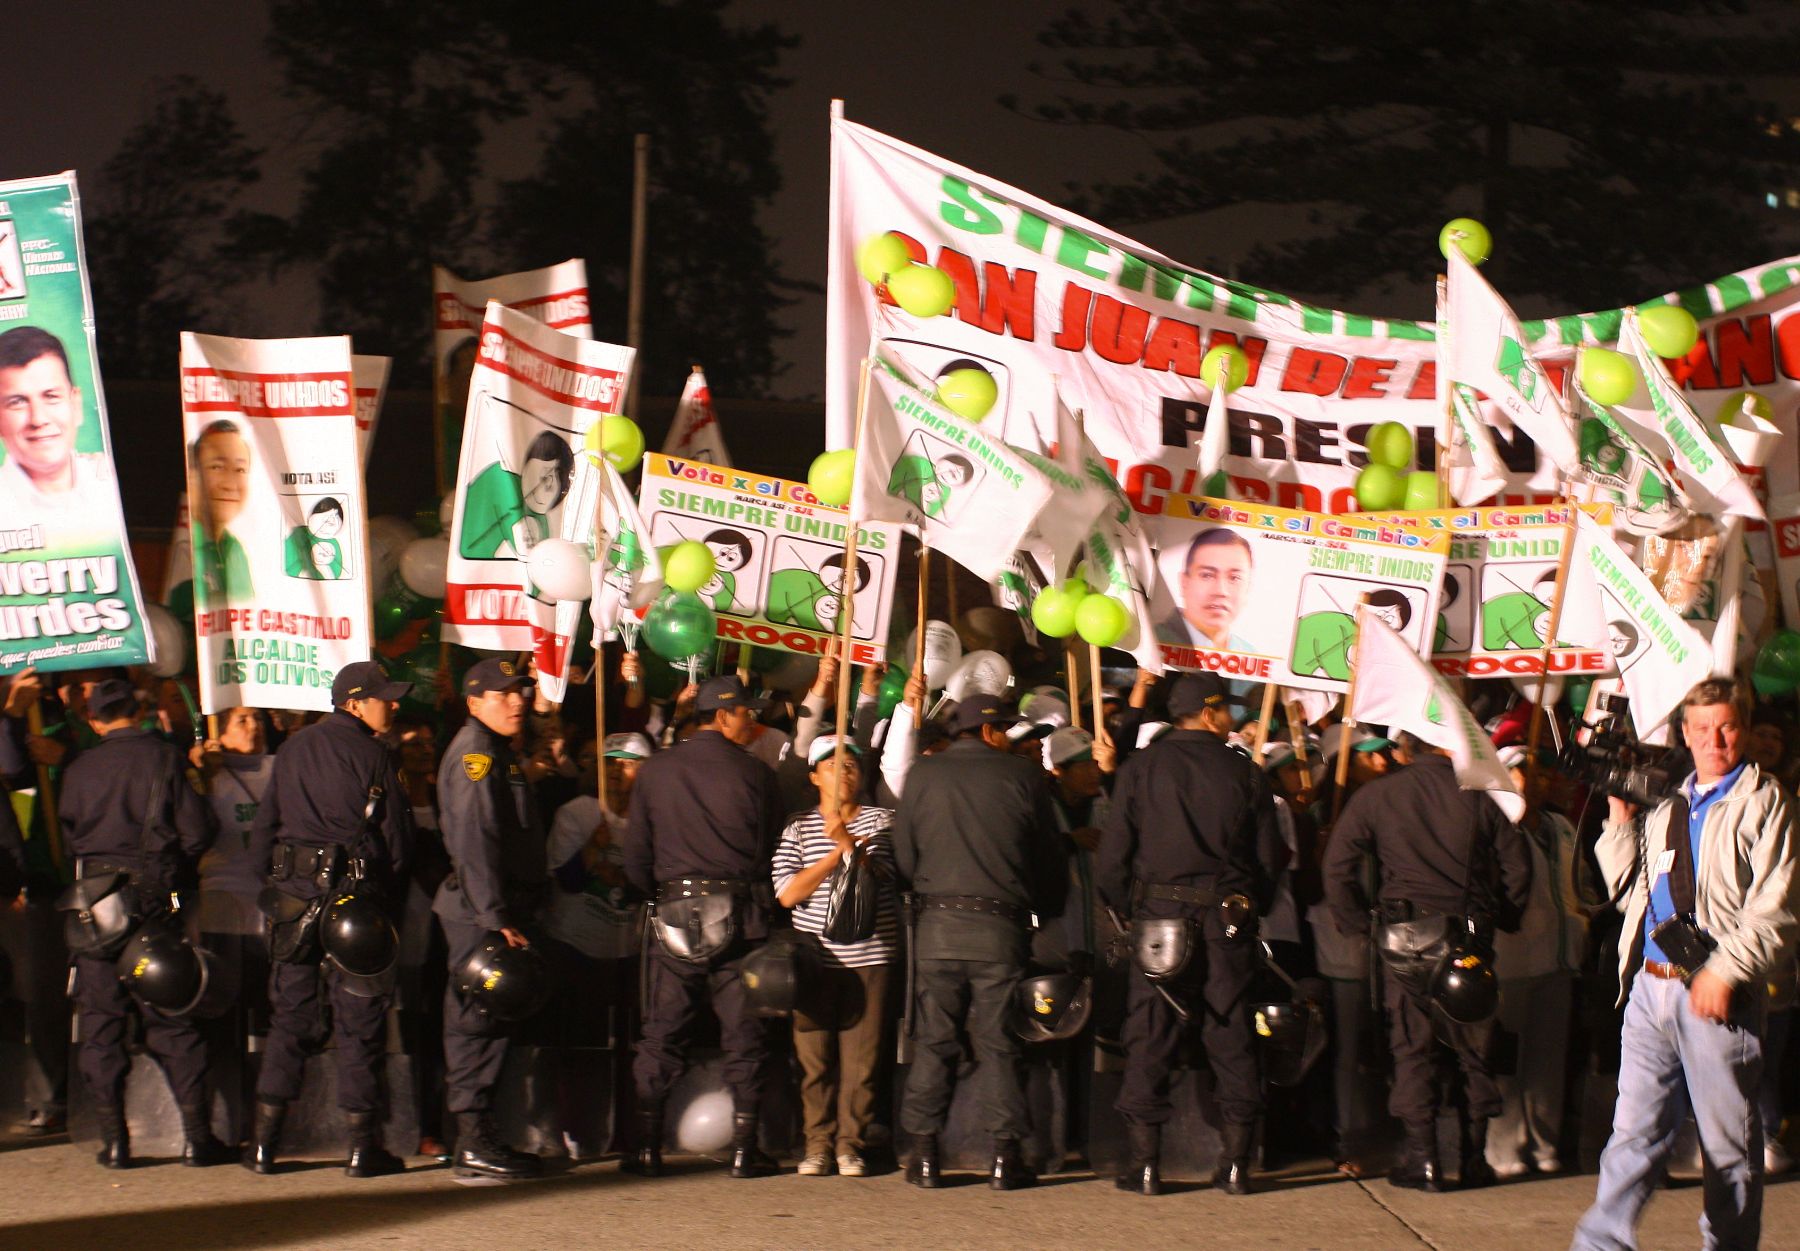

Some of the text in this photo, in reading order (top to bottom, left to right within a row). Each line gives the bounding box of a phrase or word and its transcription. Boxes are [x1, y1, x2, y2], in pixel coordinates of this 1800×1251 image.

[885, 230, 1037, 342] AN
[1280, 346, 1398, 398] DE
[264, 380, 349, 409] UNIDOS
[894, 394, 969, 446] SIEMPRE
[966, 432, 1026, 491] UNIDOS
[667, 459, 725, 486] Vota
[756, 480, 782, 498] el
[658, 488, 887, 550] SIEMPRE UNIDOS
[1188, 501, 1250, 524] Vota
[1284, 515, 1312, 532] el
[1321, 519, 1419, 547] Cambio
[0, 555, 119, 597] verry
[1308, 546, 1435, 583] SIEMPRE UNIDOS
[1589, 543, 1646, 611] SIEMPRE
[464, 589, 530, 621] VOTA
[221, 638, 321, 666] ALCALDE
[255, 662, 336, 690] OLIVOS
